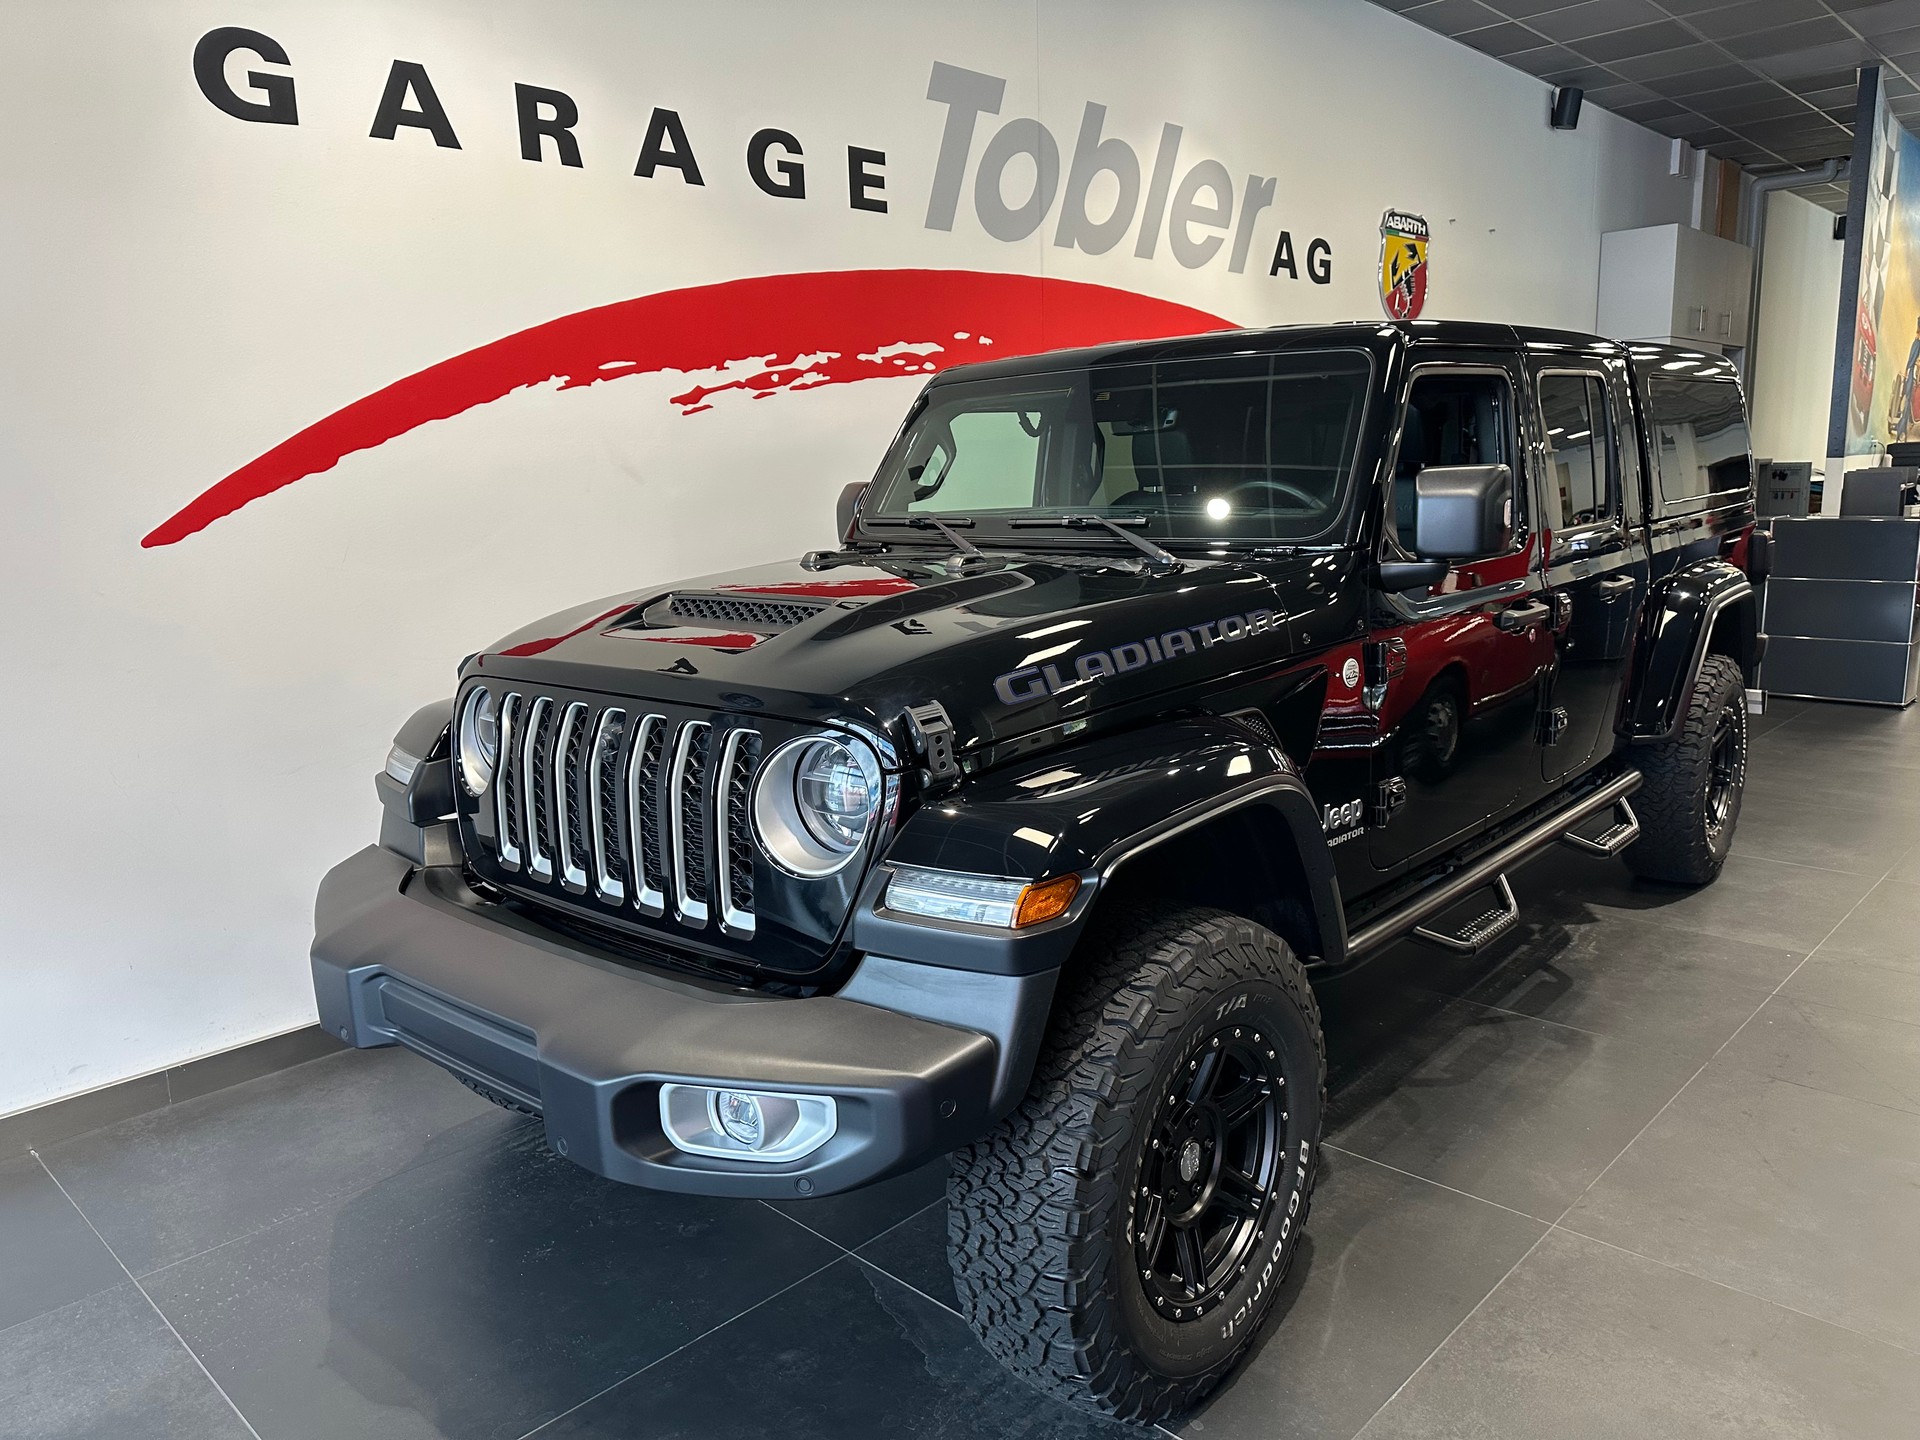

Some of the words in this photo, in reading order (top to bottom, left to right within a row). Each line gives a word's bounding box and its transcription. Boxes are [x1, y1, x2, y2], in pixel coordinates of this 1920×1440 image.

[193, 26, 889, 214] GARAGE
[924, 60, 1277, 274] Tobler
[1269, 231, 1332, 284] AG
[1386, 216, 1426, 235] ABARTH
[993, 608, 1280, 705] GLADIATOR
[1322, 798, 1363, 832] Jeep
[1327, 827, 1364, 847] ADIATOR
[1215, 993, 1248, 1020] T/A
[1221, 1139, 1309, 1339] BFGoodrich
